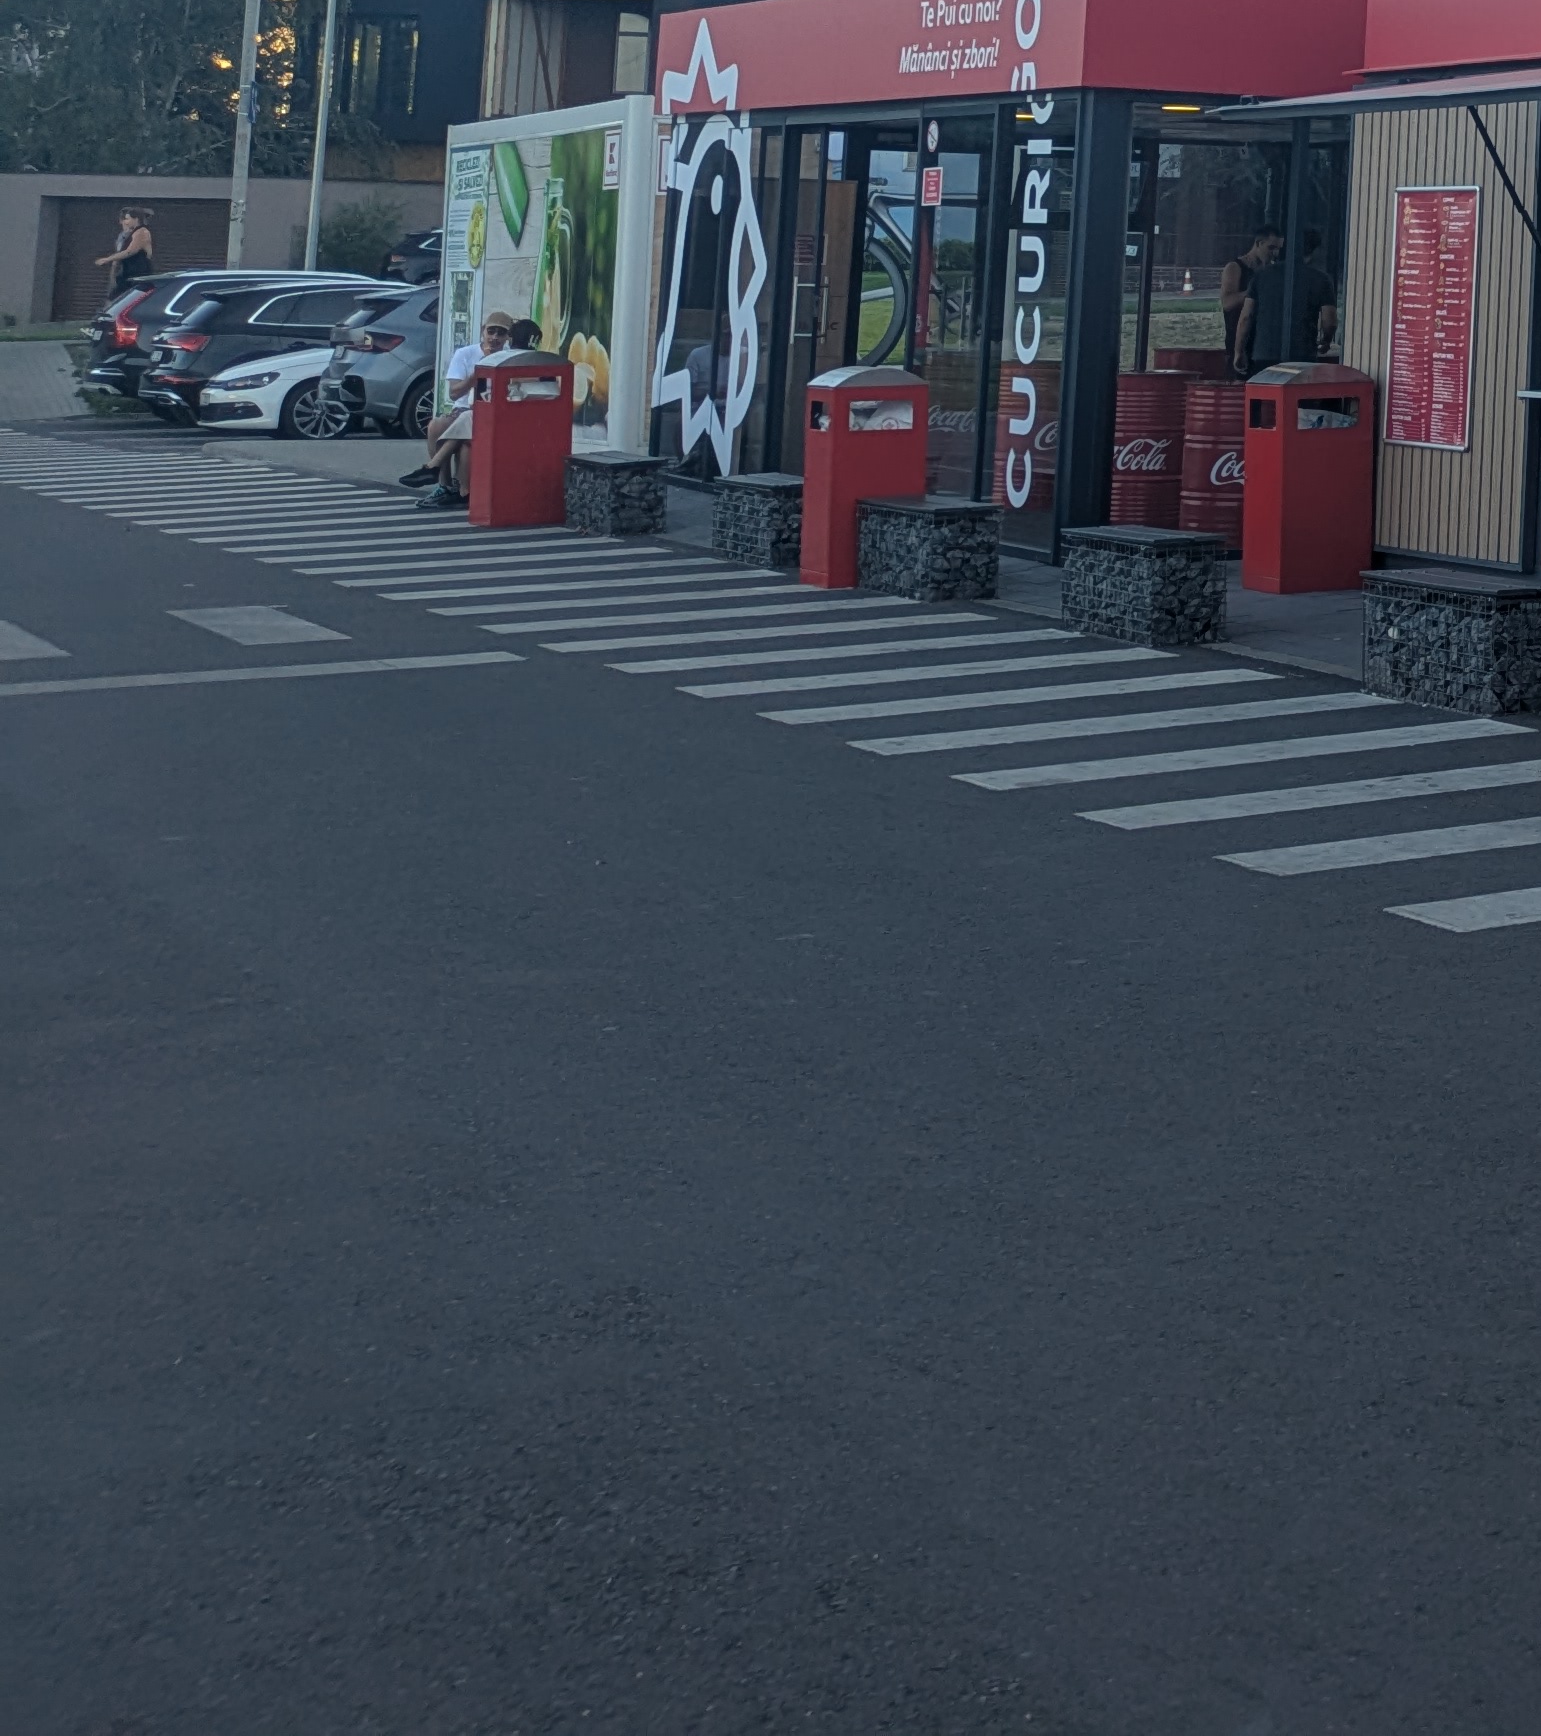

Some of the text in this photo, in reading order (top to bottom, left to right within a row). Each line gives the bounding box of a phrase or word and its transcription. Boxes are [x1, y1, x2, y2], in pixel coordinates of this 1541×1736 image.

[921, 1, 934, 27] Te
[959, 3, 972, 24] cu
[899, 38, 1000, 79] Mănânci și zbori!
